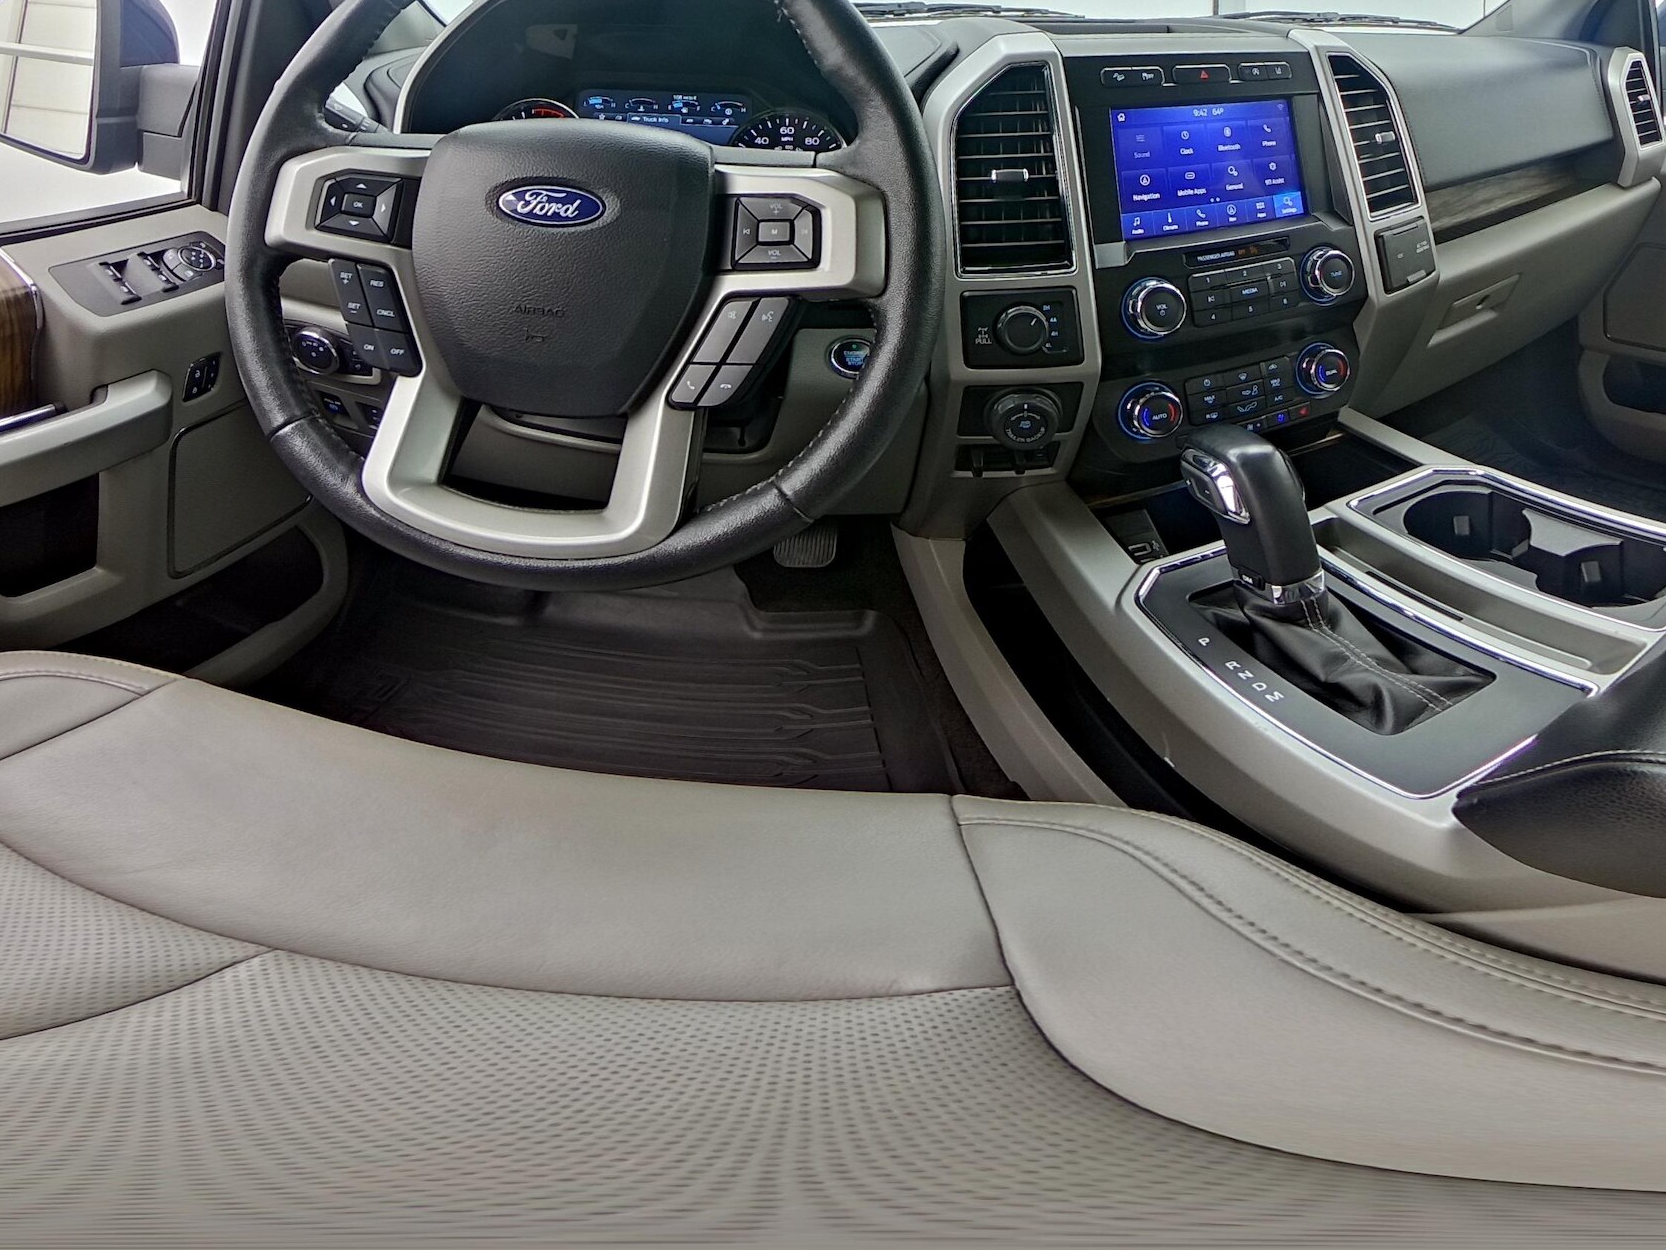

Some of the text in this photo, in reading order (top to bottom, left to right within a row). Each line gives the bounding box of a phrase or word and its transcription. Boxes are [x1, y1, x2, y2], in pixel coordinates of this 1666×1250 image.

[1192, 108, 1208, 118] 9:42
[779, 126, 795, 135] 60
[754, 137, 769, 145] 40
[804, 137, 820, 145] 80
[1262, 139, 1277, 147] Phone
[1180, 147, 1194, 155] Clock
[1217, 143, 1241, 152] Bluetooth
[1134, 151, 1151, 159] Sound
[1225, 182, 1244, 191] General
[1177, 187, 1207, 197] Mobile Apps
[1133, 192, 1160, 202] Navigation
[353, 201, 364, 209] OK
[517, 190, 581, 218] Ford
[769, 203, 783, 211] VOL
[340, 271, 353, 279] SET
[369, 279, 384, 288] RES
[1242, 286, 1259, 295] MEDIA
[347, 302, 361, 310] SET
[376, 308, 396, 318] CNCL
[975, 337, 992, 345] PULL
[363, 343, 375, 351] ON
[390, 348, 405, 356] OFF
[1152, 412, 1168, 420] AUTO
[1005, 426, 1046, 443] TRAILER BACKUP
[1198, 637, 1285, 703] P R N D M
